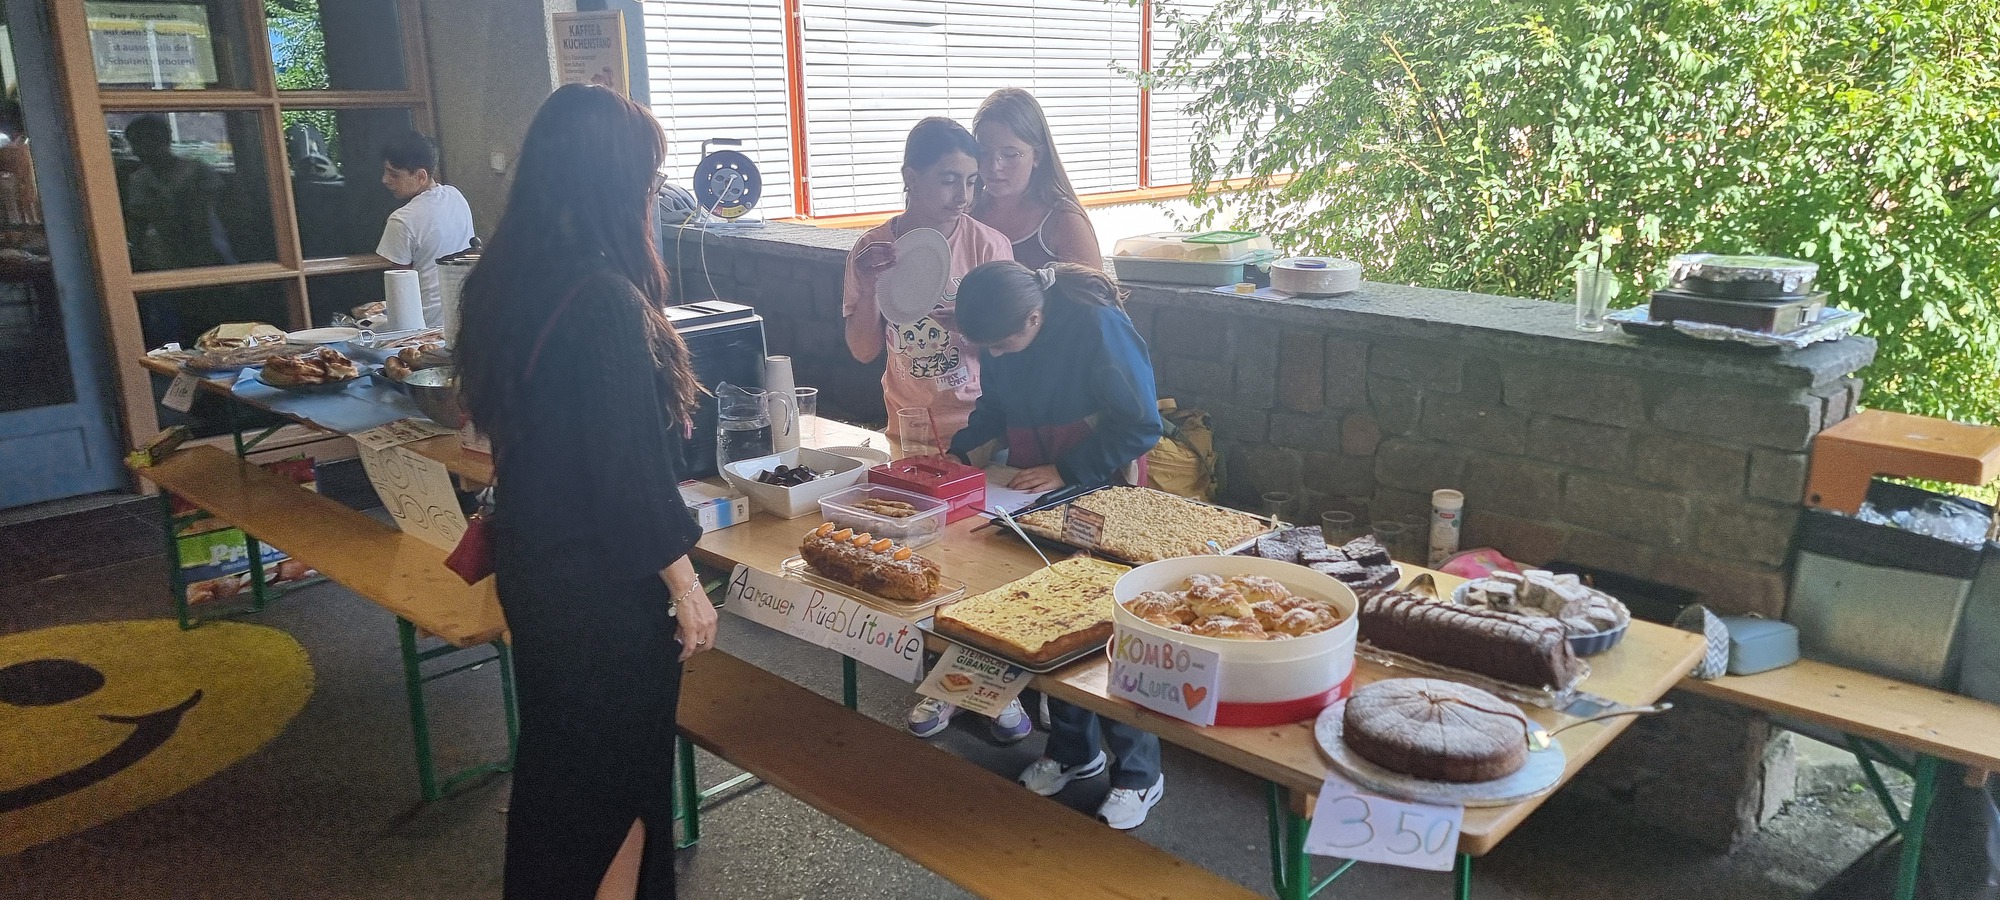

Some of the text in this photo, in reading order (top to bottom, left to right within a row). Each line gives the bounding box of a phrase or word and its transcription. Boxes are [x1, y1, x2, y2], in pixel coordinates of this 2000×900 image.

[569, 24, 596, 37] KAFFEE
[563, 37, 612, 50] KUCHENSTAND
[727, 567, 795, 616] Aargauer
[956, 655, 1000, 677] GIBANICA
